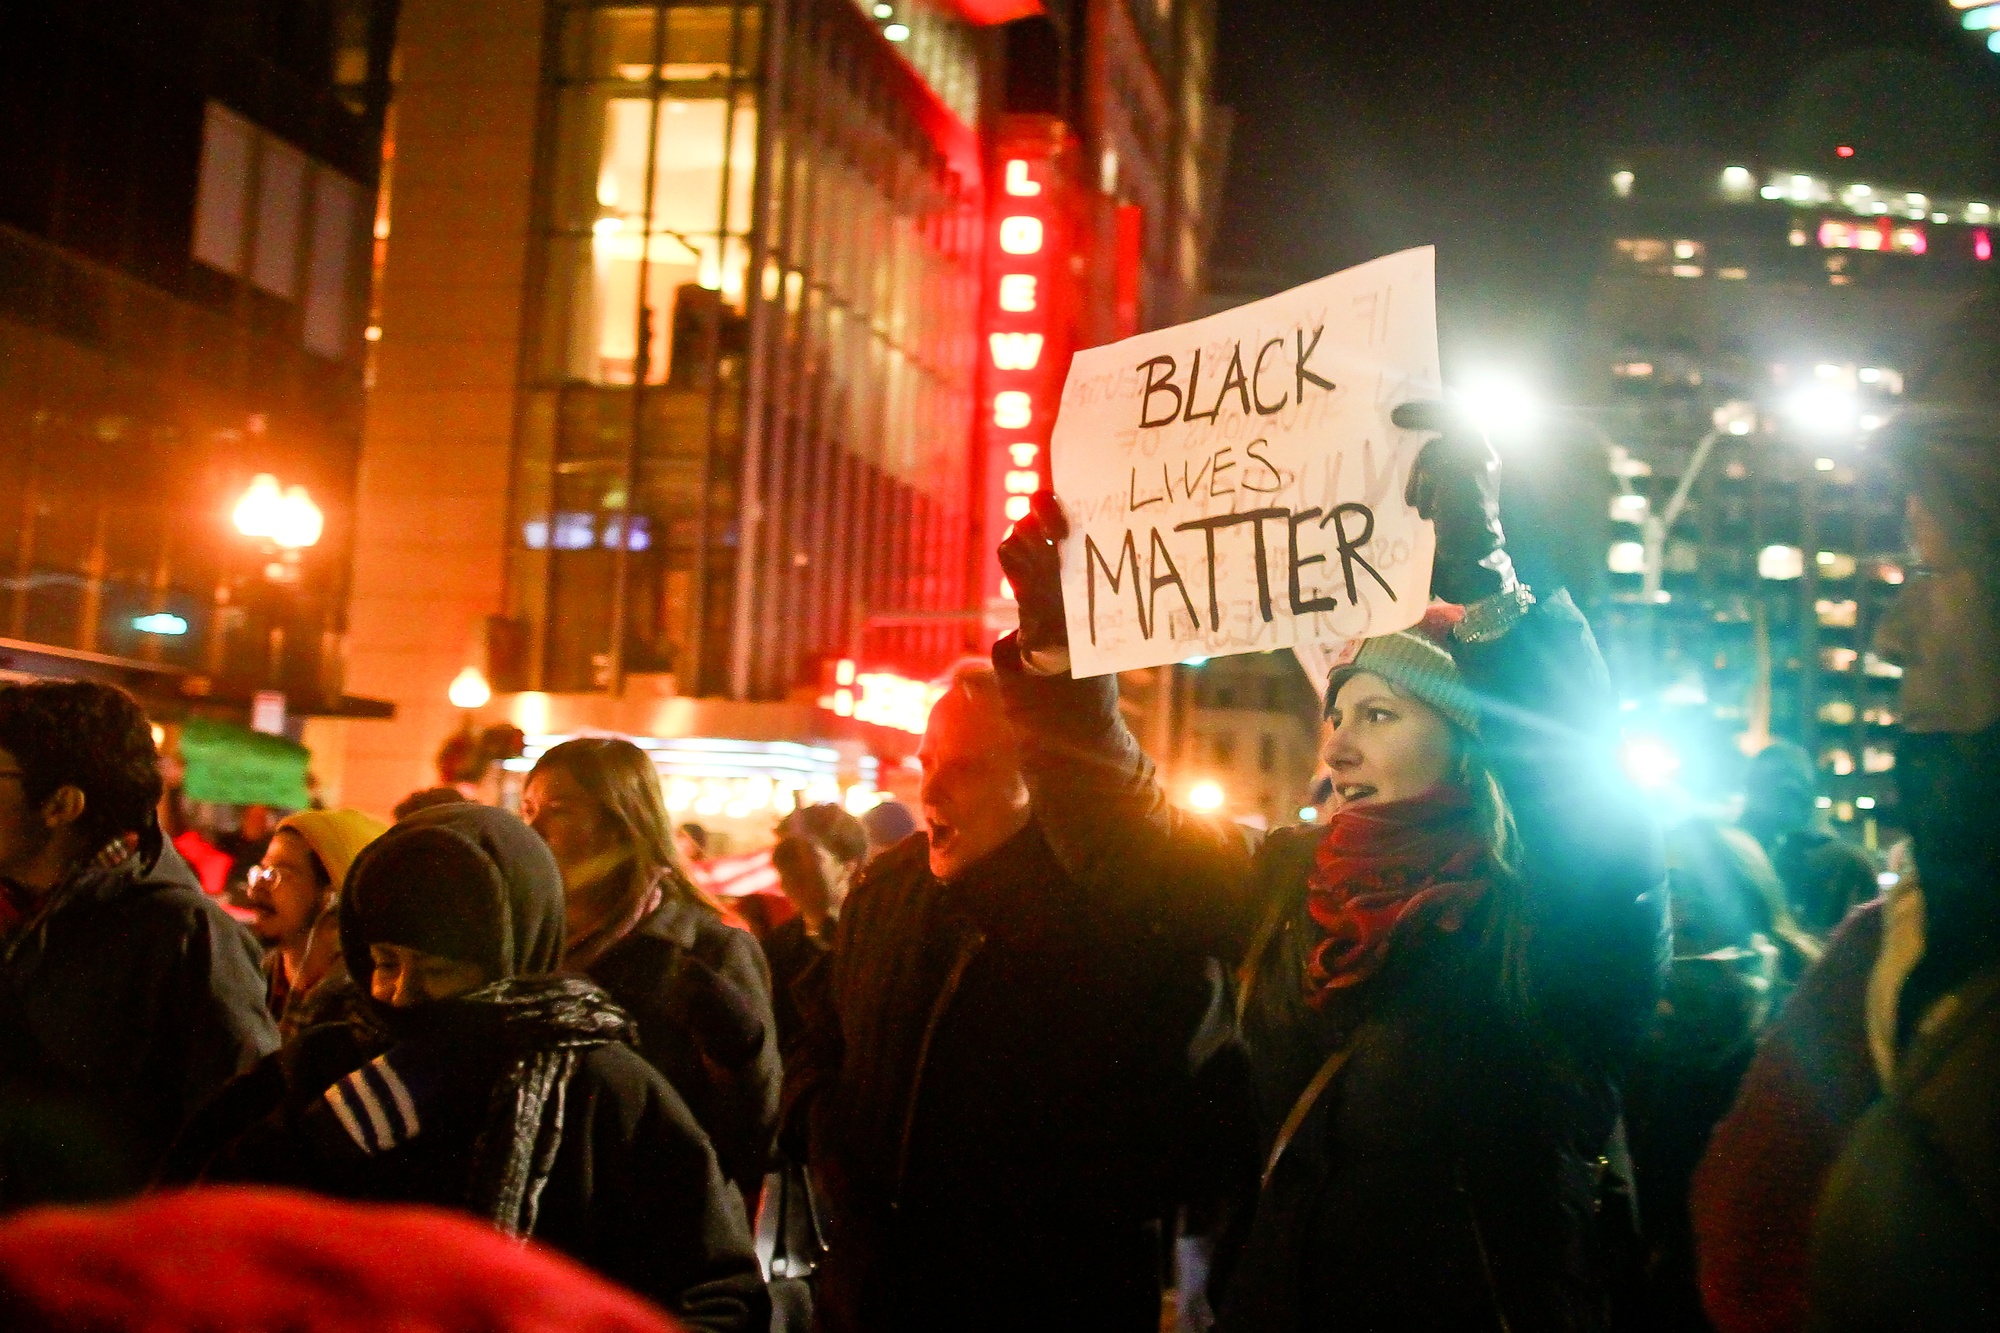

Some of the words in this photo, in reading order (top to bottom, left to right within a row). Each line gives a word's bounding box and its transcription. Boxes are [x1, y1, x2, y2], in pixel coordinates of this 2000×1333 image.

[988, 158, 1044, 429] LOEWS
[1136, 324, 1336, 428] BLACK
[1130, 438, 1282, 512] LIVES
[1085, 502, 1398, 646] MATTER
